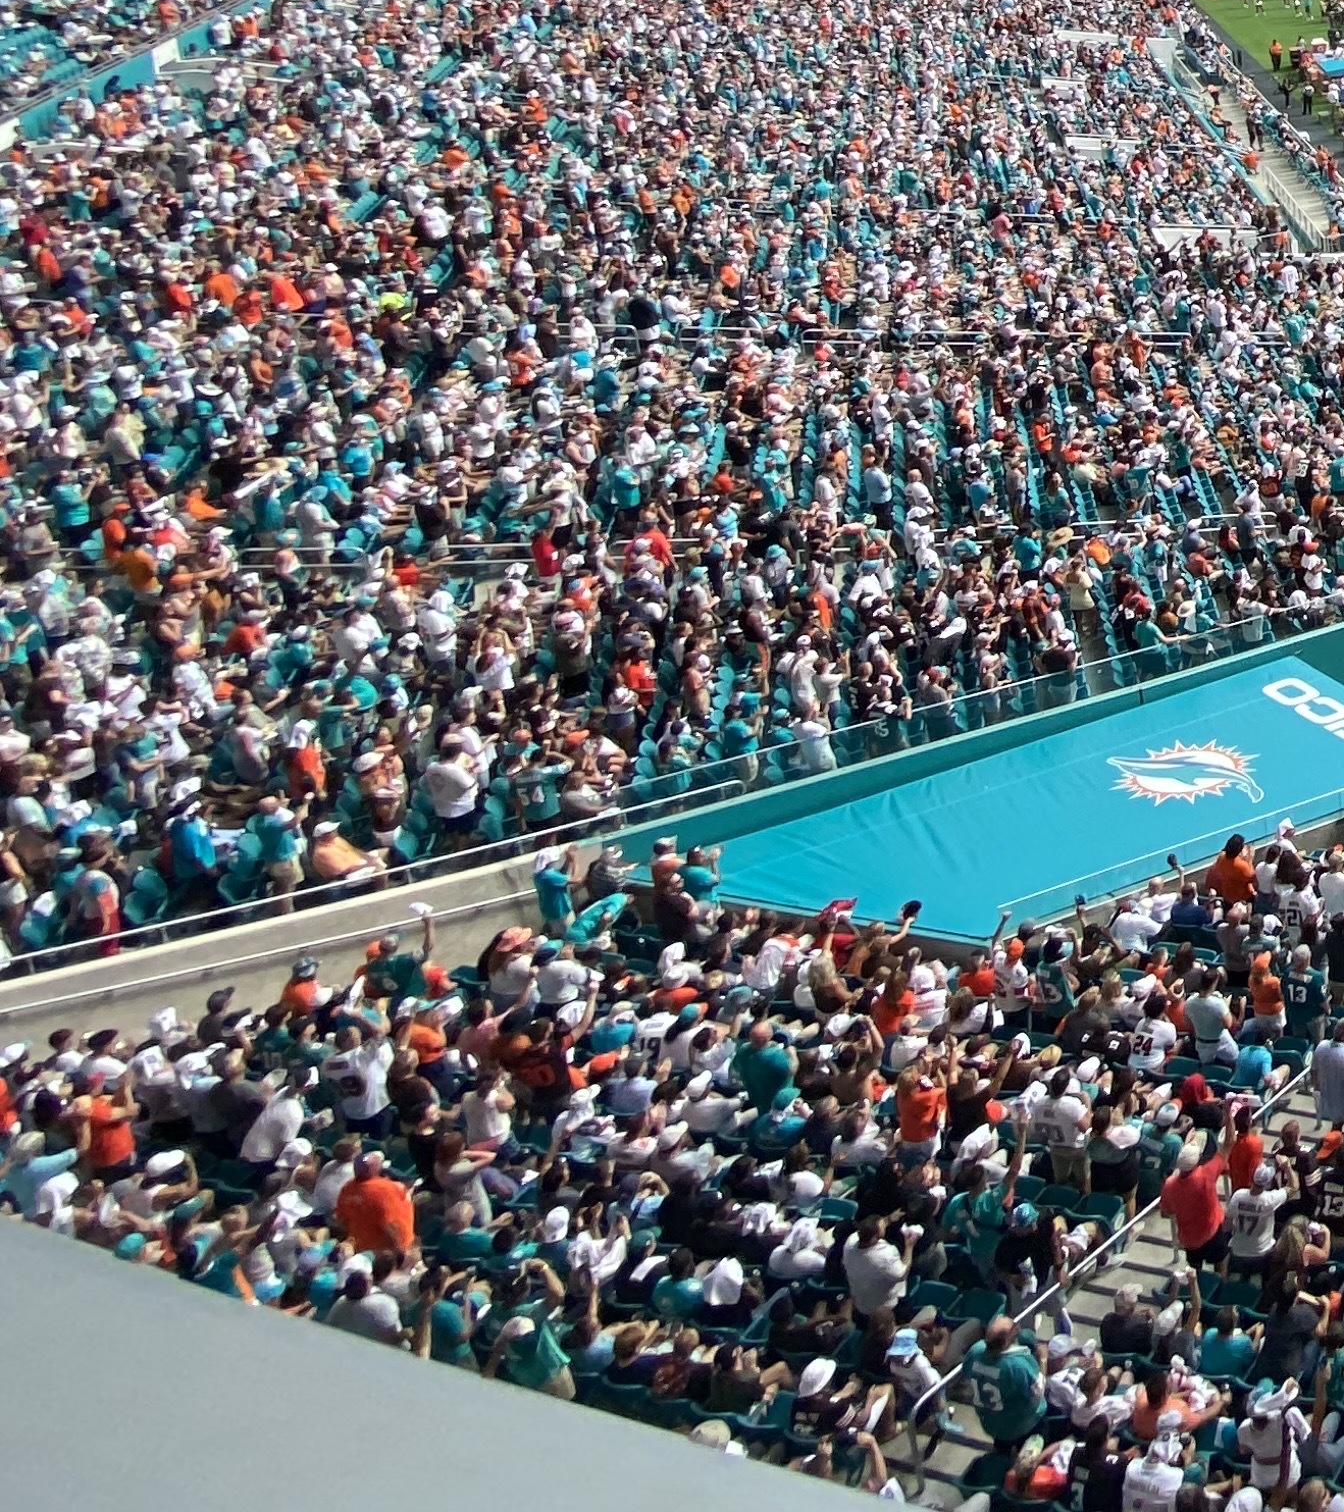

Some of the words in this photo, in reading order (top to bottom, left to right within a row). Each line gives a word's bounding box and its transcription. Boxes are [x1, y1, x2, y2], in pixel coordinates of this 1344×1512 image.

[1288, 984, 1307, 1003] 13
[1133, 1035, 1154, 1056] 24
[1238, 1216, 1259, 1235] 17
